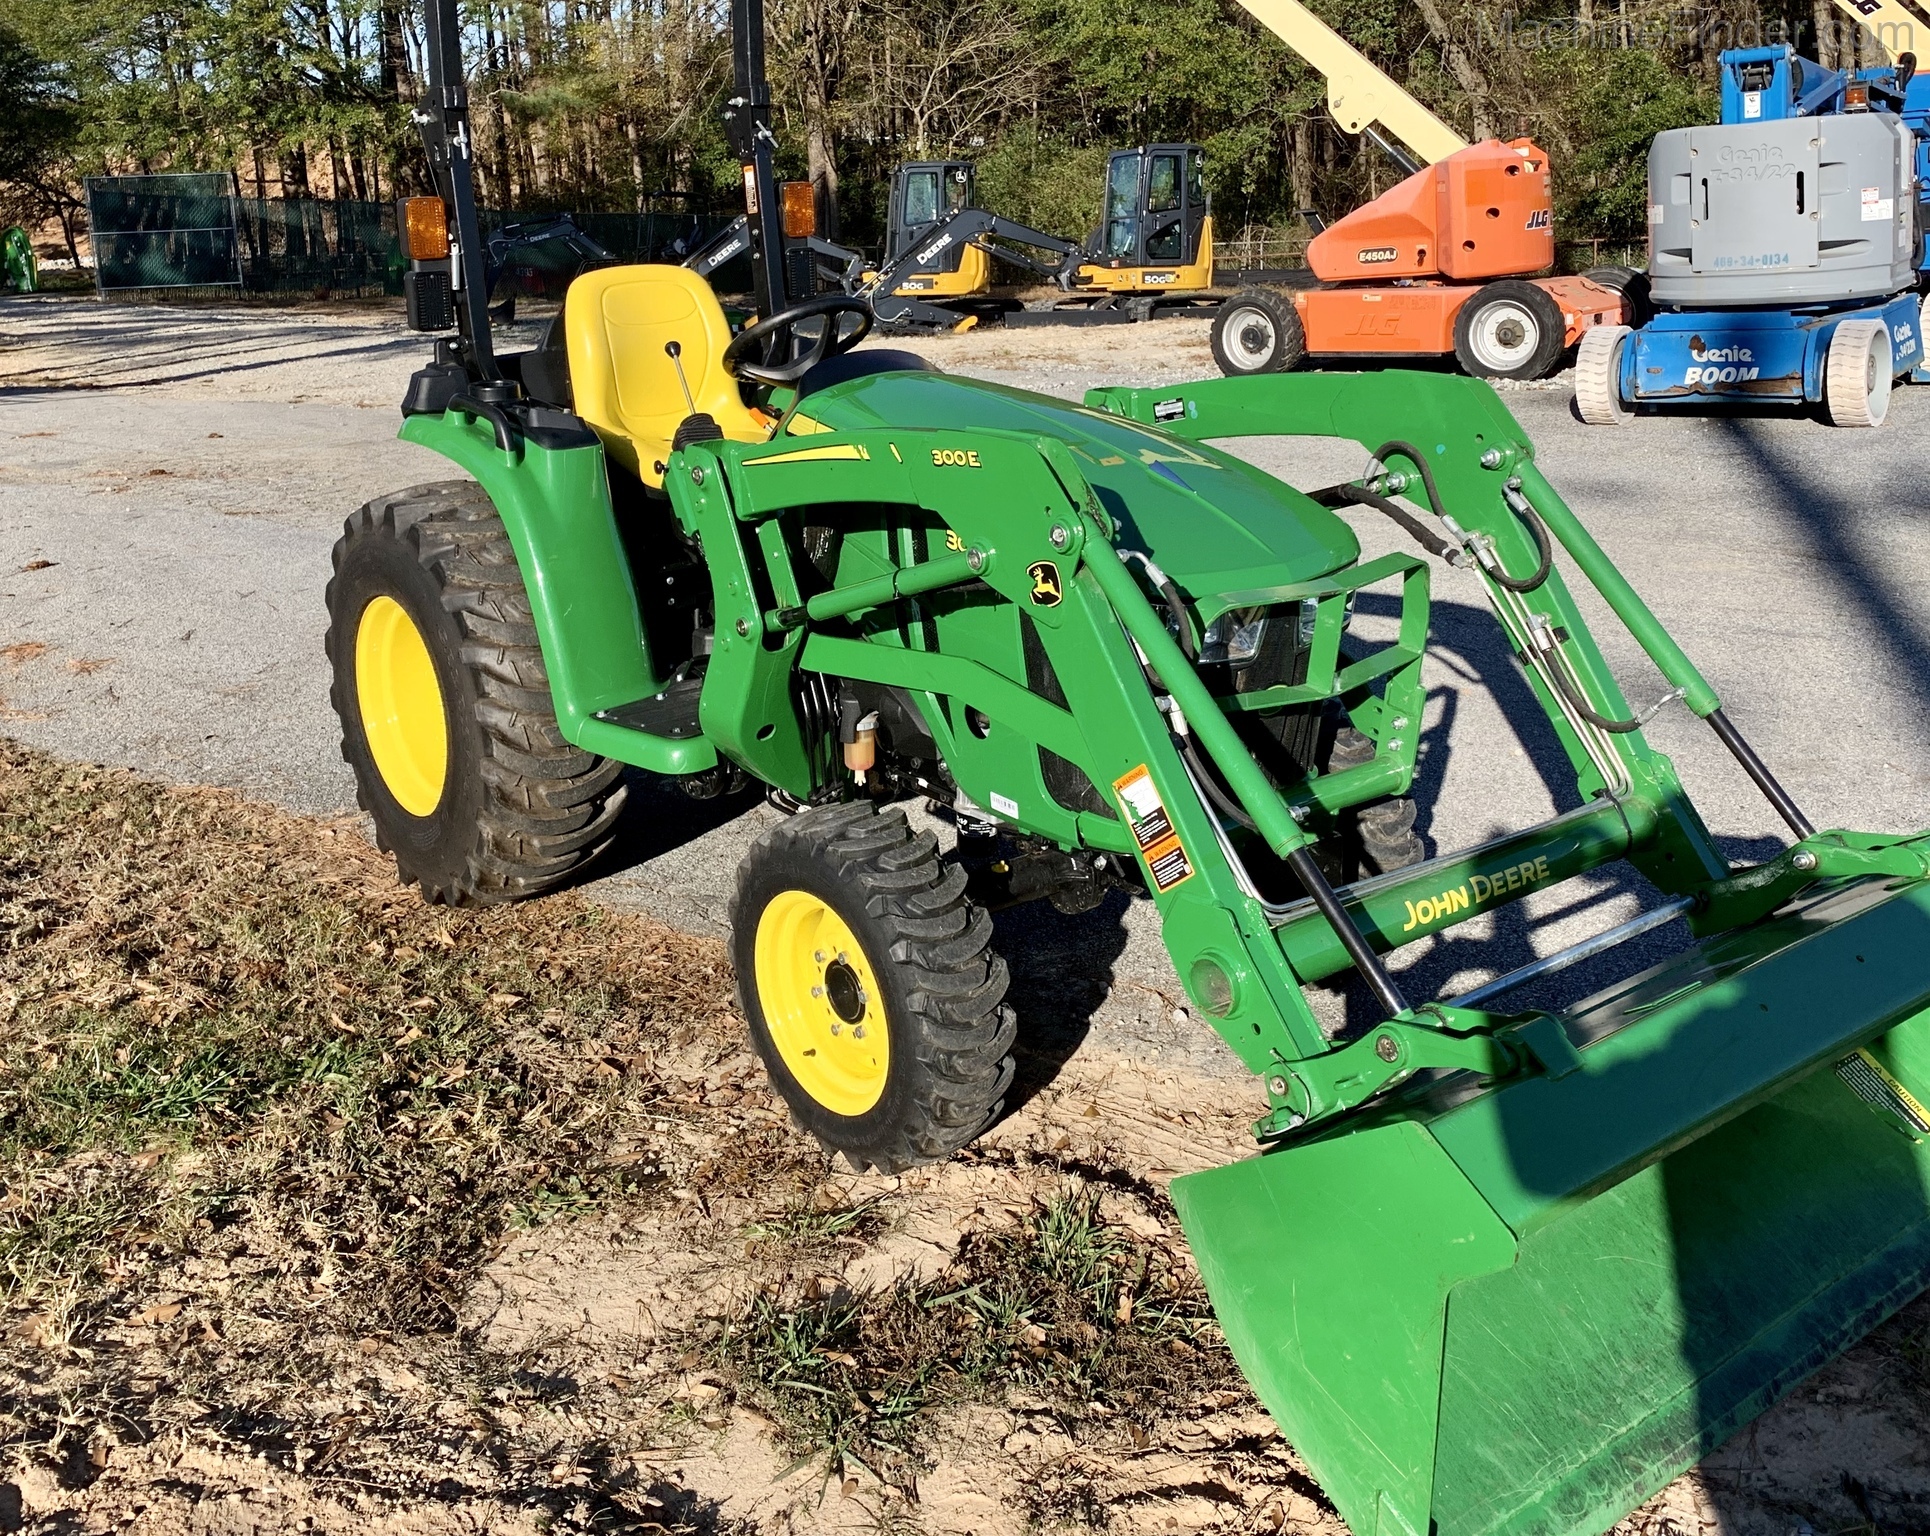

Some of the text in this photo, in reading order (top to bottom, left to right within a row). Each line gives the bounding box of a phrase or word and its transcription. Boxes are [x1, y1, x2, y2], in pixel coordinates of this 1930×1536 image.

[1718, 143, 1783, 162] Genie
[1525, 208, 1549, 230] JLG
[529, 233, 551, 242] DEERE
[708, 239, 741, 266] DEERE
[916, 233, 953, 265] DEERE
[1358, 249, 1397, 262] E450AJ
[902, 281, 924, 290] 50G
[1144, 275, 1166, 284] 50G
[1344, 313, 1400, 336] JLG
[1691, 345, 1754, 363] Genie
[1684, 366, 1760, 385] BOOM
[1121, 769, 1144, 787] WARNING
[1154, 840, 1177, 859] WARNING
[1403, 855, 1550, 932] JOHN DEERE
[1888, 1079, 1922, 1112] CAUTION
